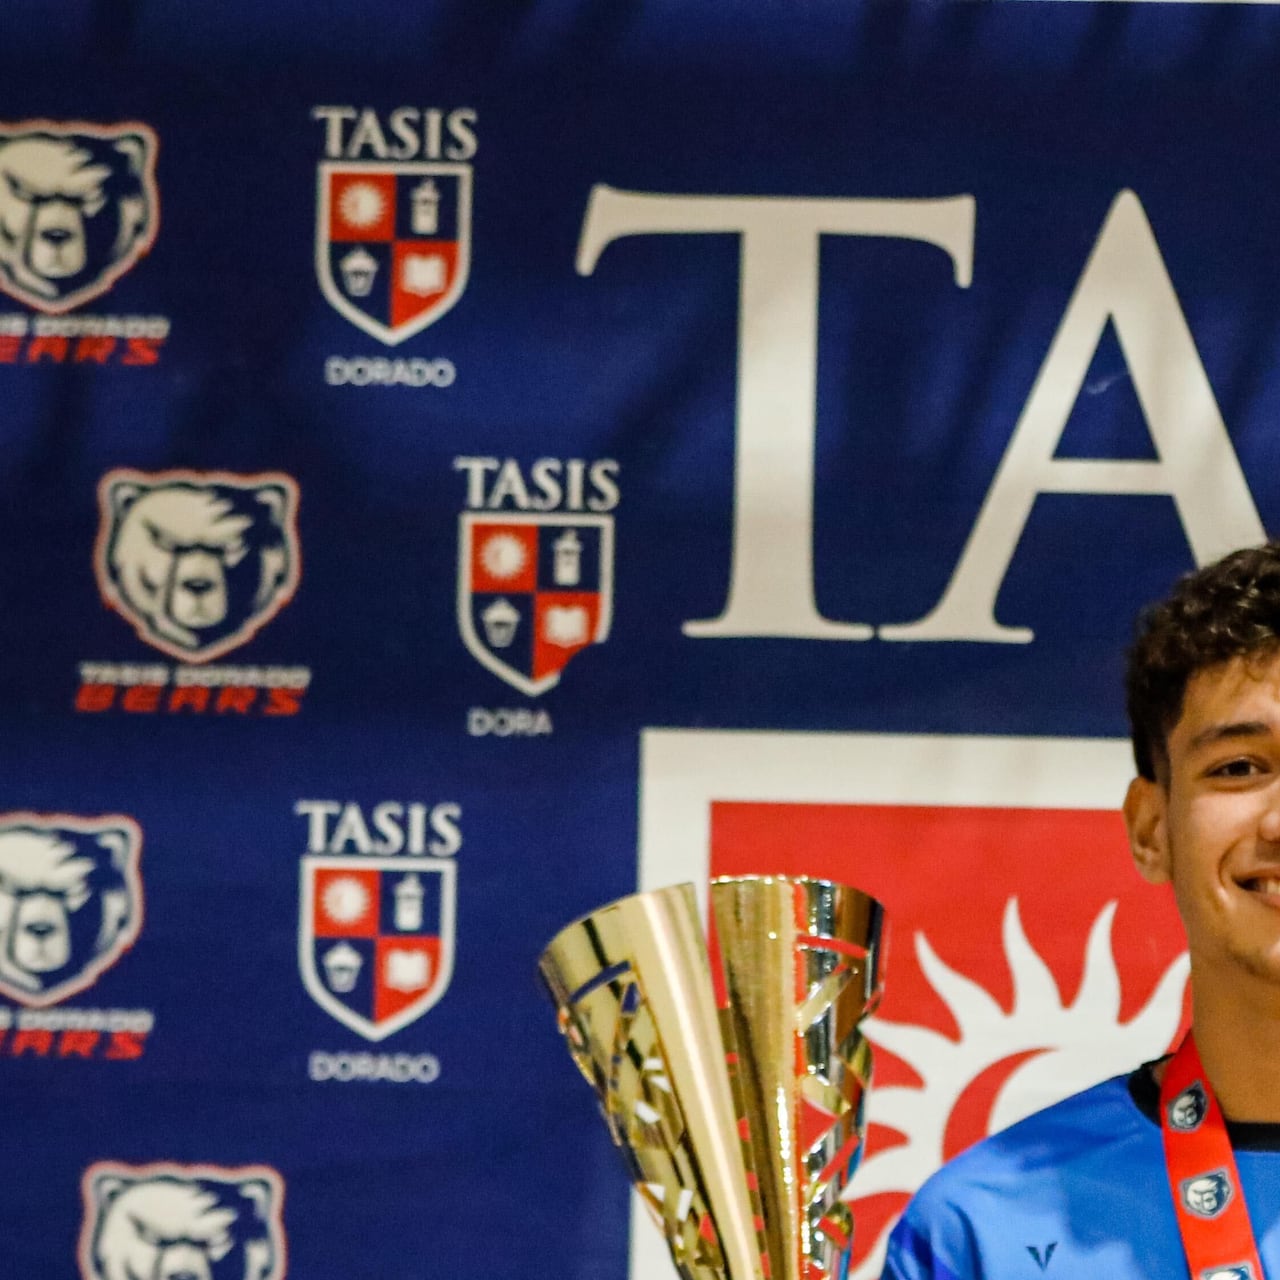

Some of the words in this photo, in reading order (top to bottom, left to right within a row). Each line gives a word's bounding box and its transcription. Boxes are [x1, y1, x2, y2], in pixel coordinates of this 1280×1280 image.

[314, 106, 478, 161] TASIS
[325, 356, 457, 388] DORADO
[454, 456, 620, 511] TASIS
[467, 708, 553, 738] DORA
[296, 799, 462, 855] TASIS
[309, 1051, 440, 1083] DORADO
